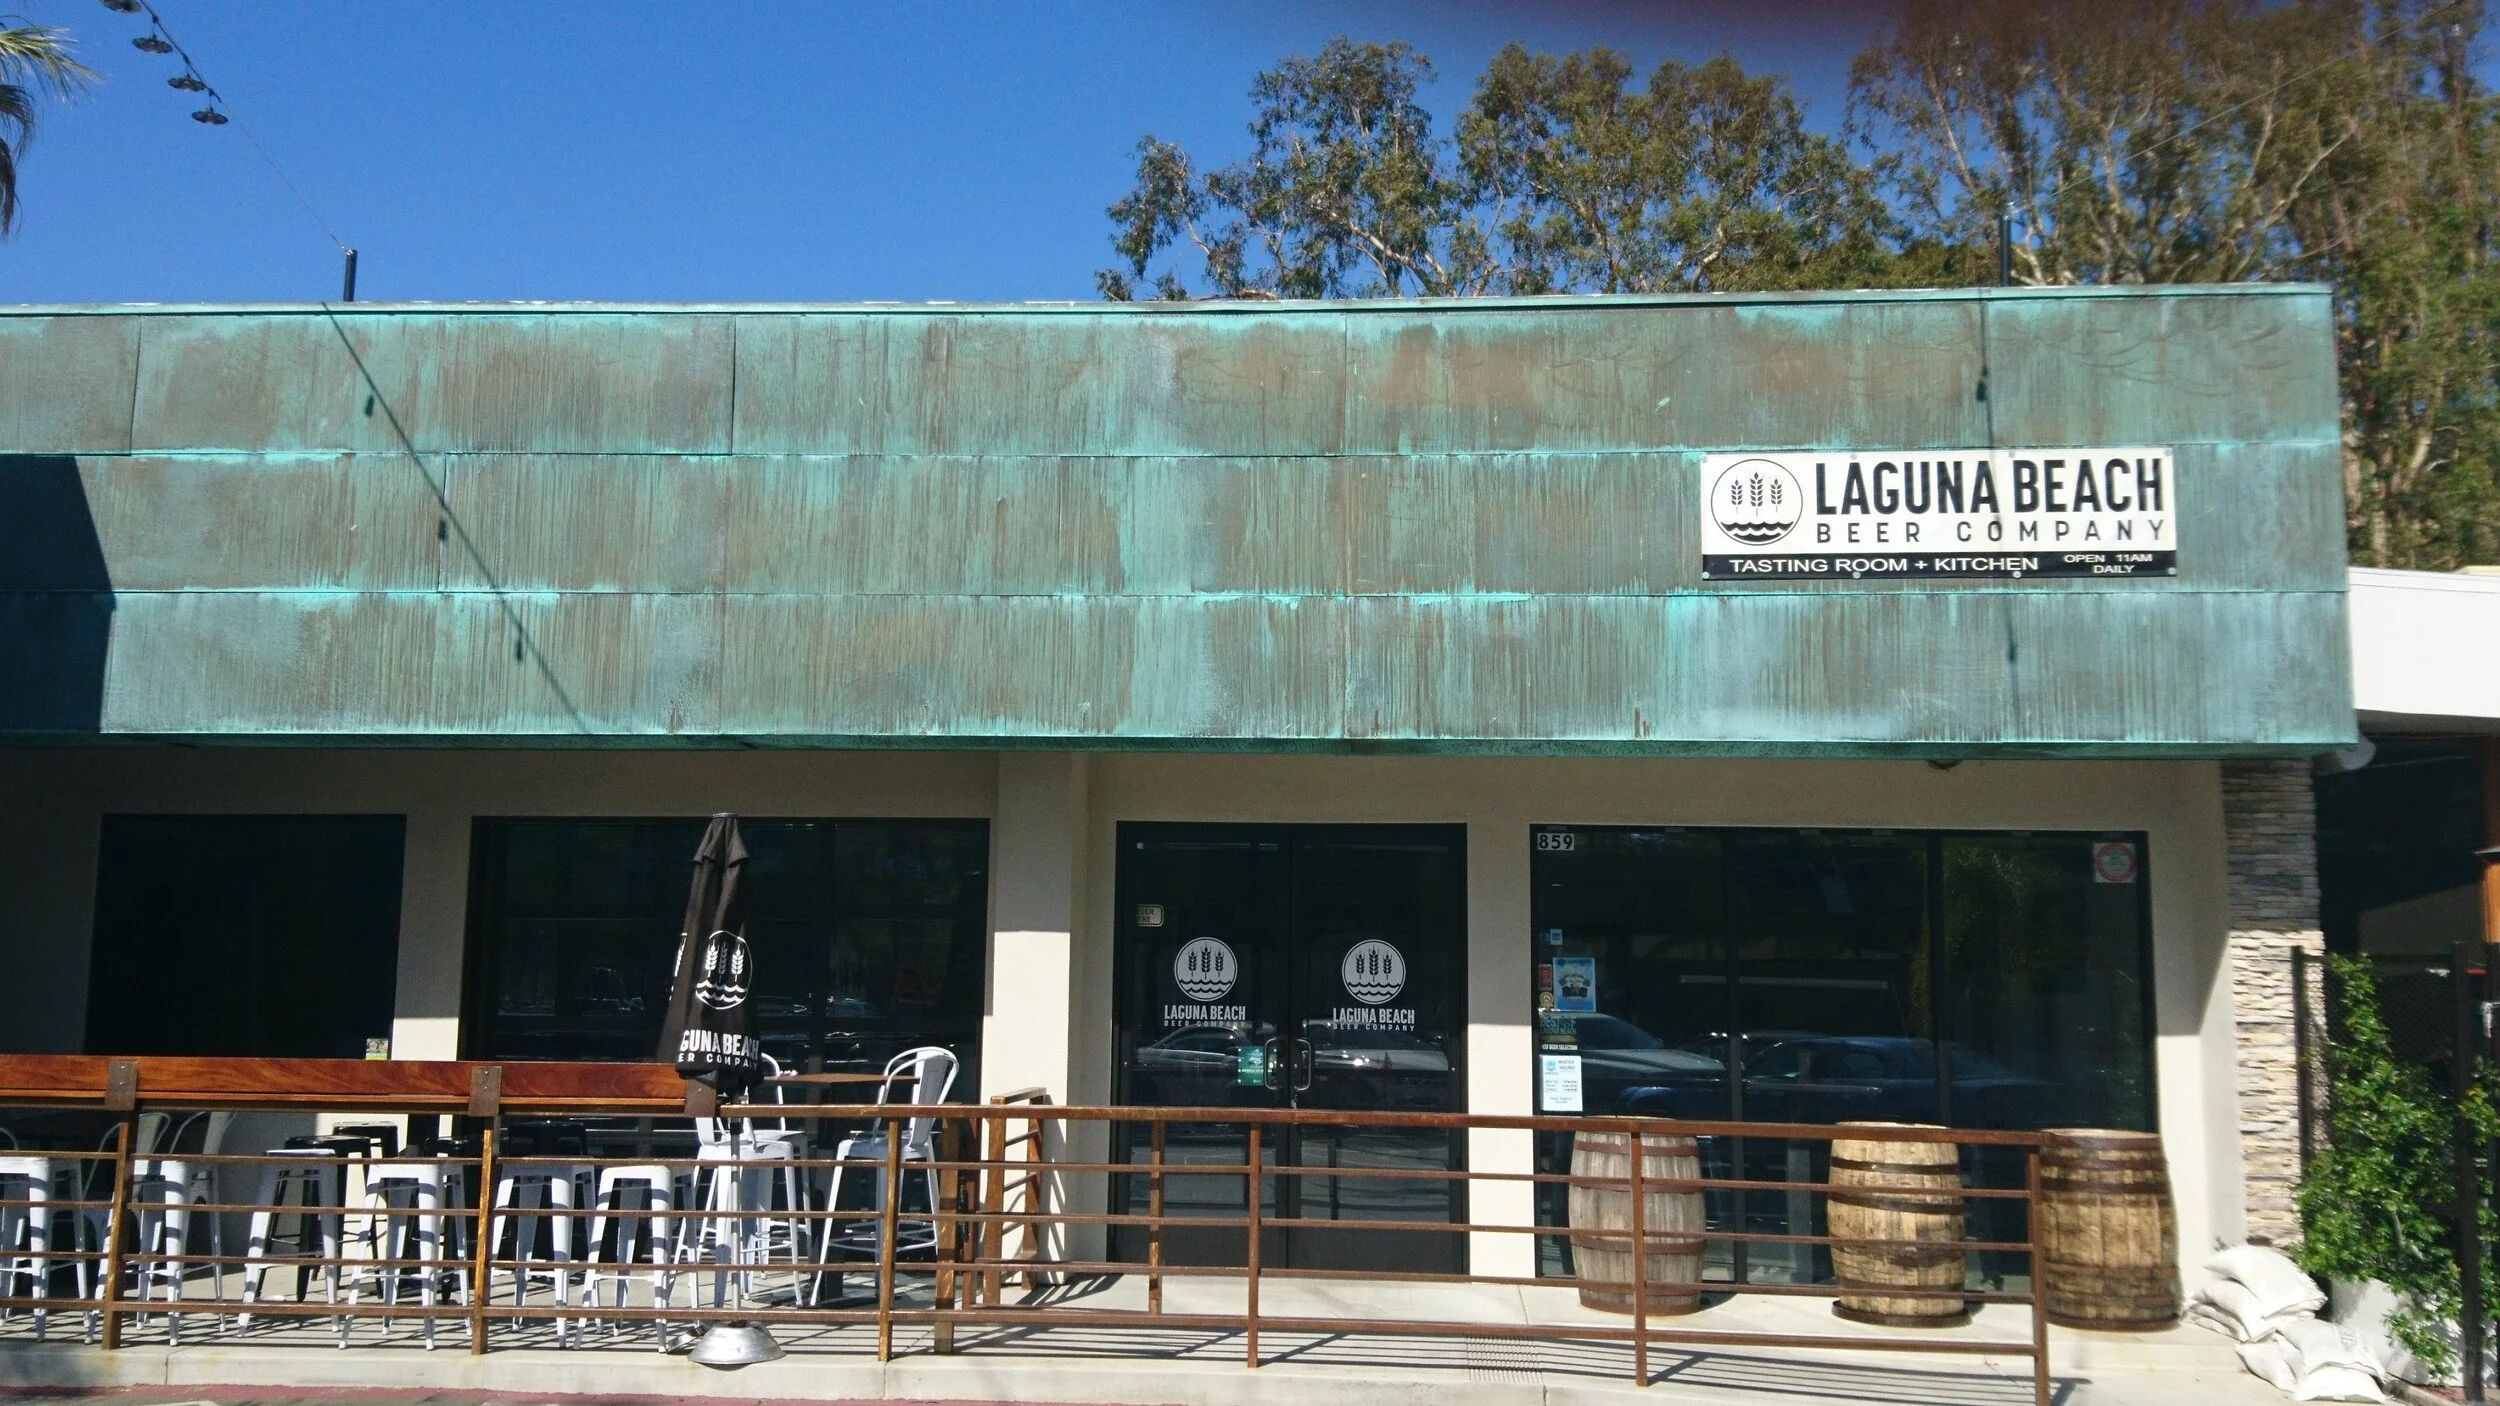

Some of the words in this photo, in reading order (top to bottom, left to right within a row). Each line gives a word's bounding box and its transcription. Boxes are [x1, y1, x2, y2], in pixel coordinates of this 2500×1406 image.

[1816, 461, 1999, 515] LAGUNA
[2013, 458, 2163, 513] BEACH
[1816, 522, 1920, 543] BEER
[1956, 519, 2164, 542] COMPANY
[1729, 558, 1829, 573] TASTING
[1835, 558, 1908, 572] ROOM
[1914, 560, 1928, 570] +
[1934, 556, 2039, 571] KITCHEN
[2063, 554, 2106, 563] OPEN
[2115, 553, 2153, 562] 11AM
[2092, 564, 2135, 574] DAILY
[1538, 834, 1573, 850] 859
[1164, 1004, 1208, 1020] LAGUNA
[1210, 1005, 1246, 1020] BEACH
[1333, 1007, 1377, 1023] LAGUNA
[1379, 1009, 1415, 1024] BEACH
[1196, 1020, 1246, 1028] COMPANY
[1365, 1024, 1415, 1032] COMPANY
